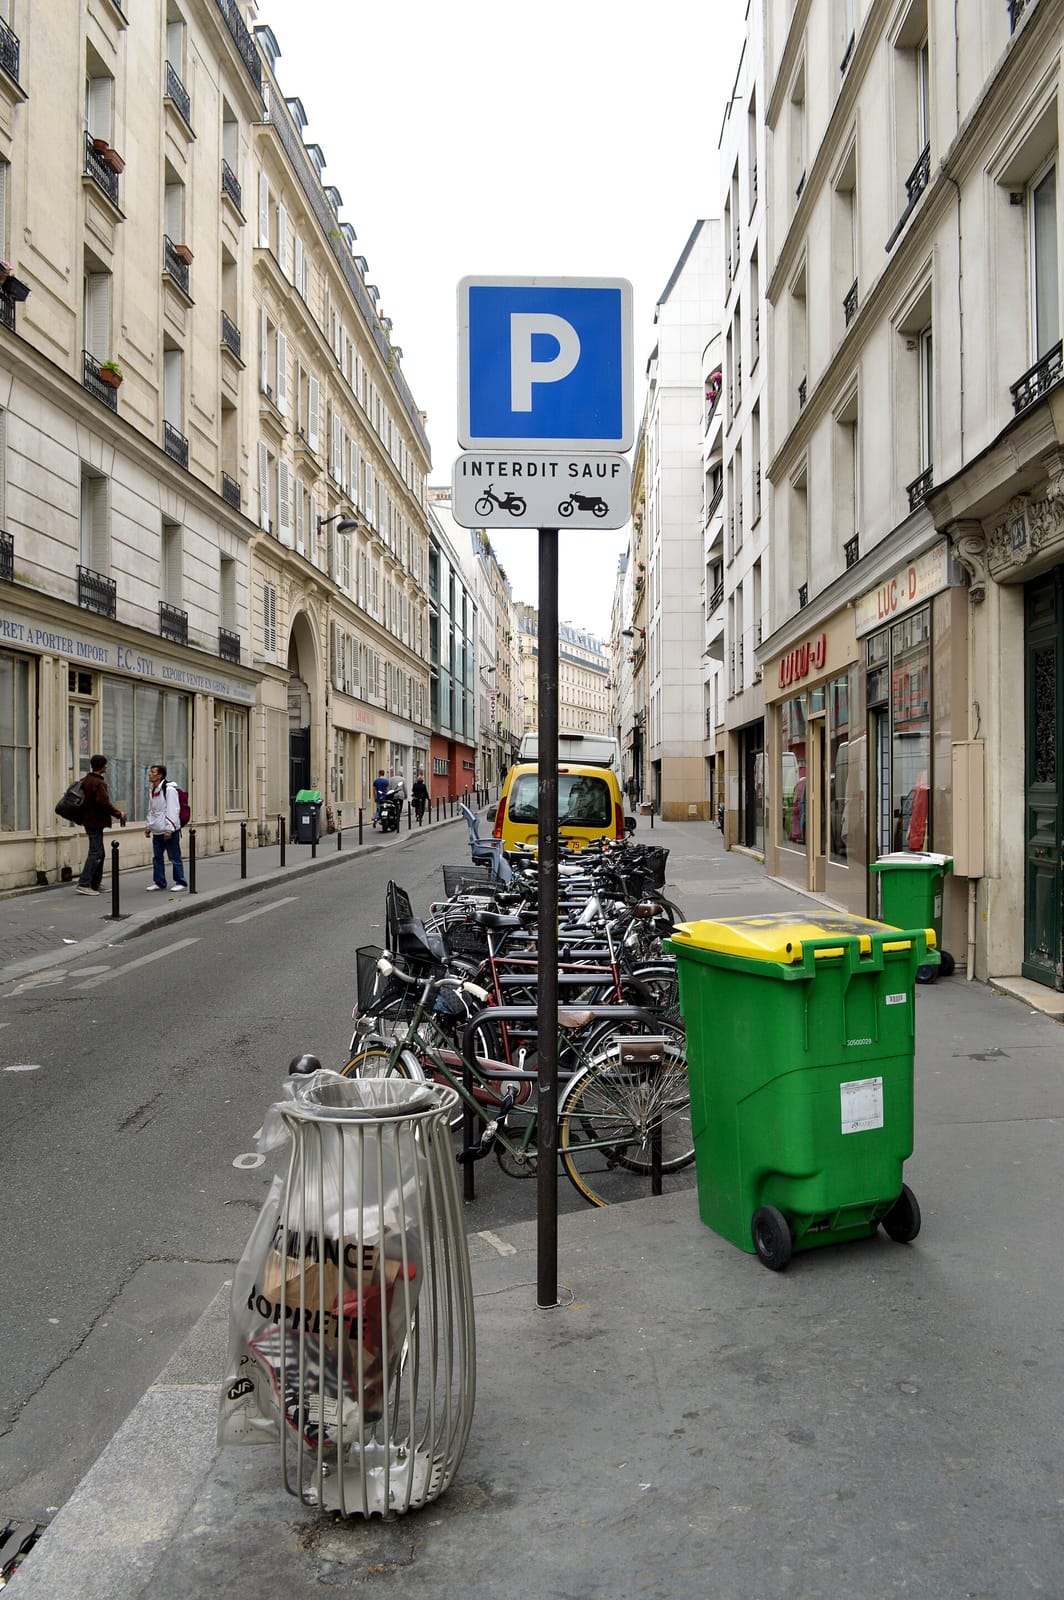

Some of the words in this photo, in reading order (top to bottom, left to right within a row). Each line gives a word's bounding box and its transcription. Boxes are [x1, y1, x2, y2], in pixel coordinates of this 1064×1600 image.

[510, 312, 581, 412] P
[463, 461, 559, 478] INTERDIT
[568, 463, 621, 479] SAUF
[878, 579, 898, 620] LUC
[908, 567, 917, 600] D
[27, 628, 34, 644] A
[35, 629, 73, 654] PORTER
[76, 641, 109, 663] IMPORT
[231, 1381, 253, 1398] NF
